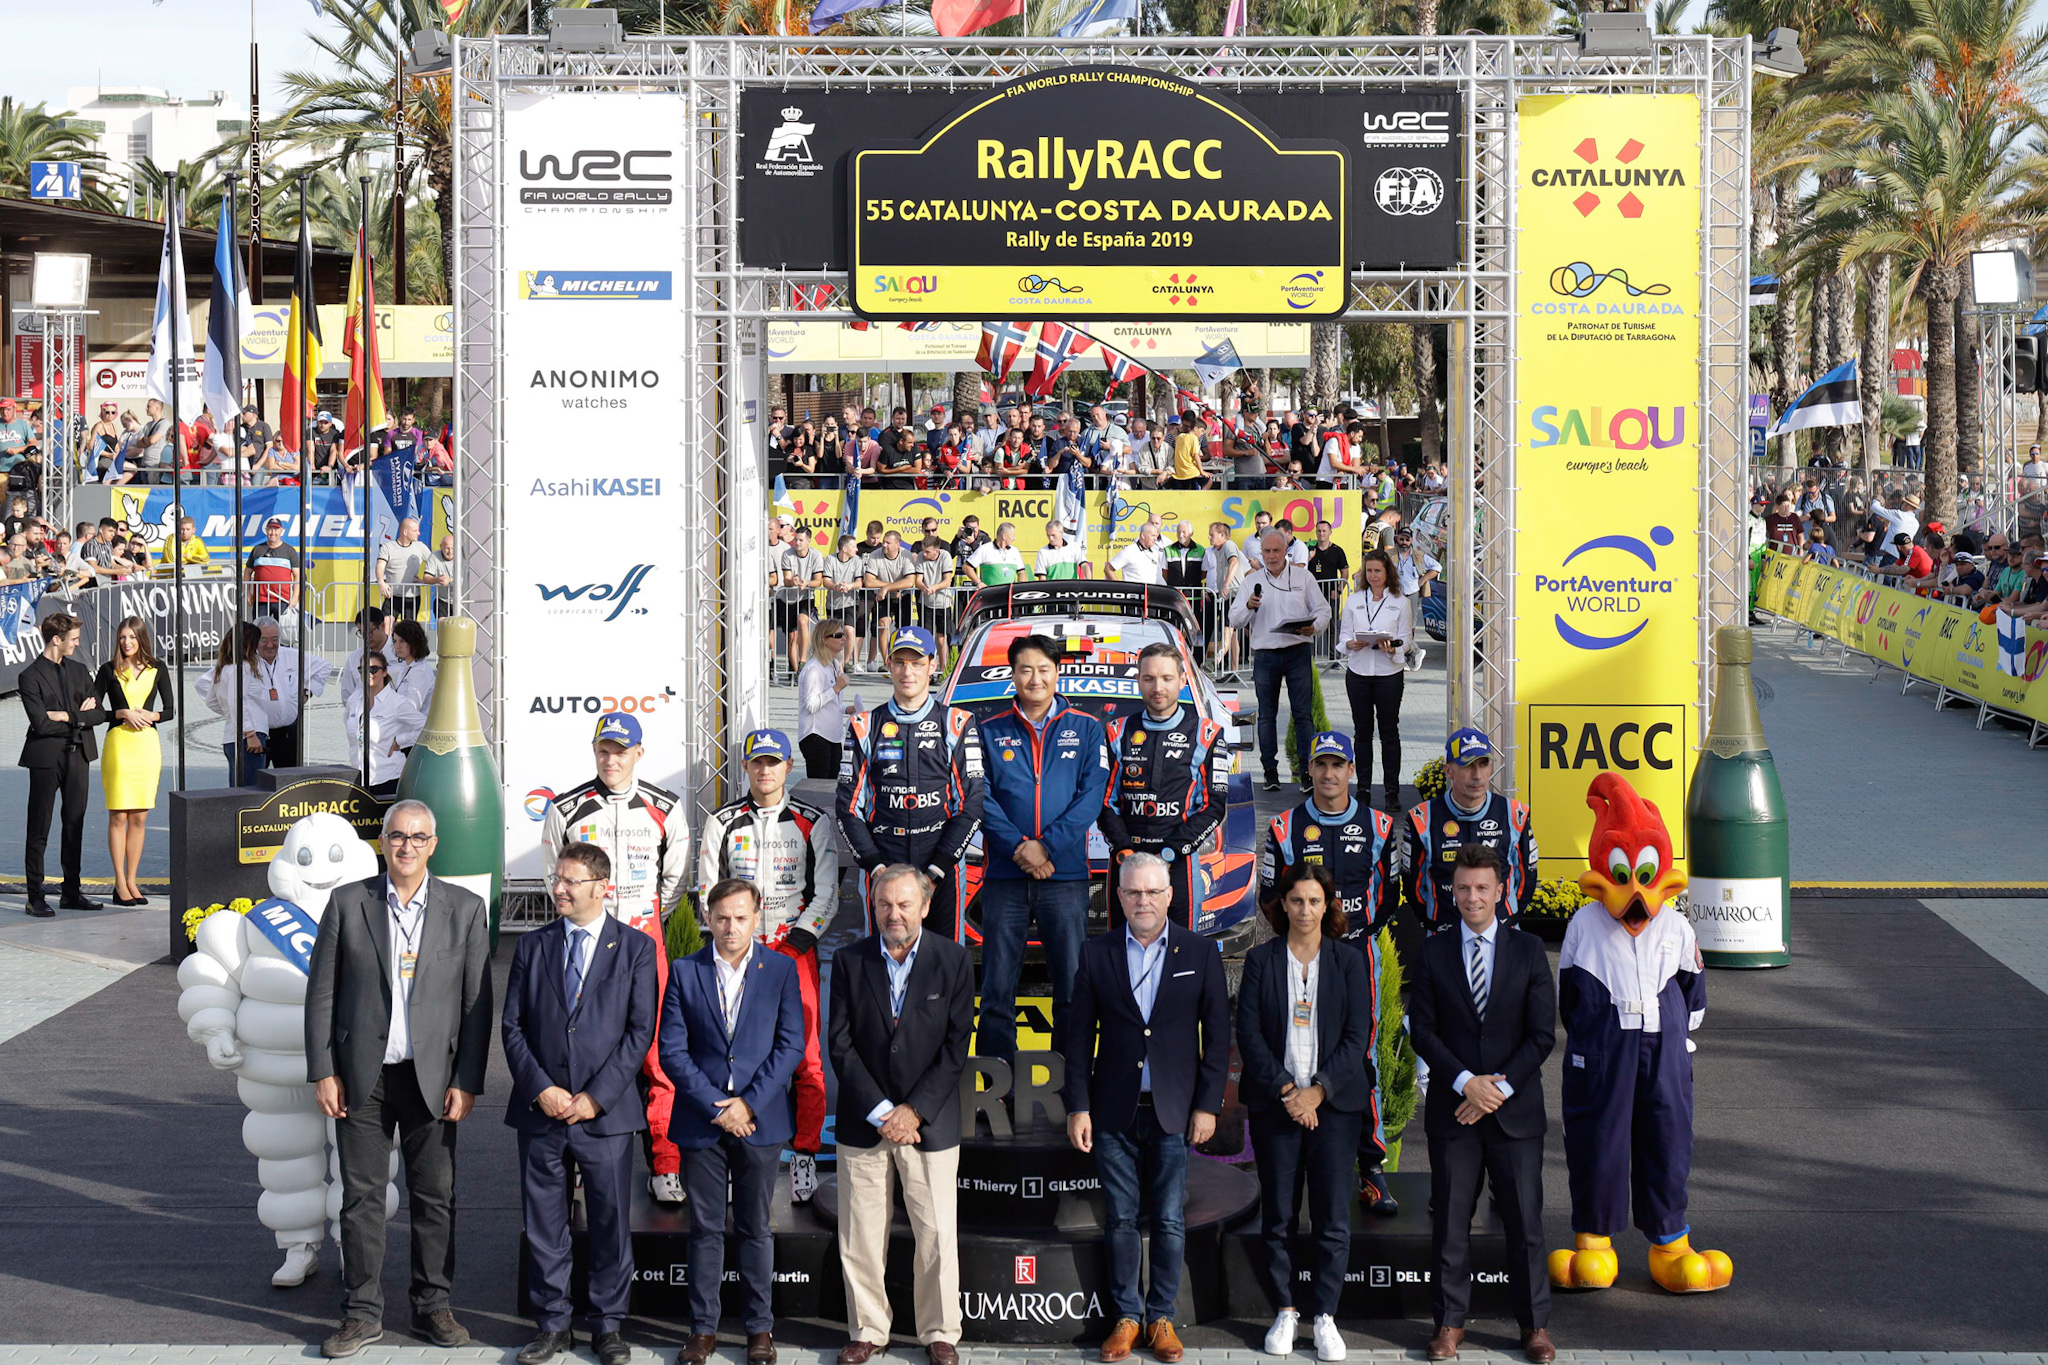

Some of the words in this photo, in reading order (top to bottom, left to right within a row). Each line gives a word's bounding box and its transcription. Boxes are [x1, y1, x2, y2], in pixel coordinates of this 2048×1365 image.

[1006, 84, 1026, 98] FIA
[1026, 74, 1068, 90] WORLD
[1070, 72, 1104, 82] RALLY
[1106, 72, 1195, 97] CHAMPIONSHIP
[1364, 112, 1450, 130] WRC
[396, 110, 404, 198] GALICIA
[520, 149, 672, 181] WRC
[799, 163, 824, 171] Española
[977, 136, 1222, 191] RallyRACC
[251, 104, 260, 244] EXTREMADURA
[1532, 168, 1686, 186] CATALUNYA
[524, 192, 548, 200] FIA
[552, 192, 609, 200] WORLD
[613, 193, 668, 201] RALLY
[866, 200, 894, 221] 55
[1172, 200, 1333, 222] DAURADA
[1006, 230, 1050, 251] Rally
[1056, 230, 1078, 248] de
[1083, 230, 1146, 251] España
[1151, 231, 1194, 248] 2019
[561, 280, 660, 292] MICHELIN
[874, 275, 938, 294] SALOU
[1152, 285, 1214, 294] CATALUNYA
[1531, 302, 1590, 315] COSTA
[1596, 302, 1685, 315] DAURADA
[376, 313, 391, 330] CC
[1114, 328, 1172, 336] CATALUNYA
[530, 370, 660, 388] ANONIMO
[562, 396, 628, 408] watches
[1530, 405, 1685, 450] SALOU
[1615, 457, 1649, 472] beach
[998, 500, 1048, 518] RACC
[201, 514, 373, 538] MICHEL
[1535, 574, 1672, 593] PortAventura
[1056, 592, 1144, 600] HYUNDAI
[1567, 596, 1640, 612] WORLD
[3, 627, 46, 666] AUTO
[1059, 664, 1114, 675] UNDAI
[530, 696, 656, 714] AUTODOC
[999, 738, 1022, 747] MOBIS
[1540, 722, 1673, 770] RACC
[882, 786, 917, 794] HYUNDAI
[279, 800, 360, 818] RallyRACC
[888, 791, 940, 810] MOBIS
[1130, 801, 1180, 817] MOBIS
[242, 825, 252, 834] 55
[600, 827, 652, 838] Microsoft
[1692, 904, 1772, 924] SUMARROCA
[973, 1179, 1018, 1195] Thierry
[1048, 1178, 1102, 1192] GILSOUL
[642, 1270, 664, 1282] Ott
[676, 1269, 685, 1280] 2
[1376, 1270, 1385, 1282] 3
[1396, 1271, 1421, 1282] DEL
